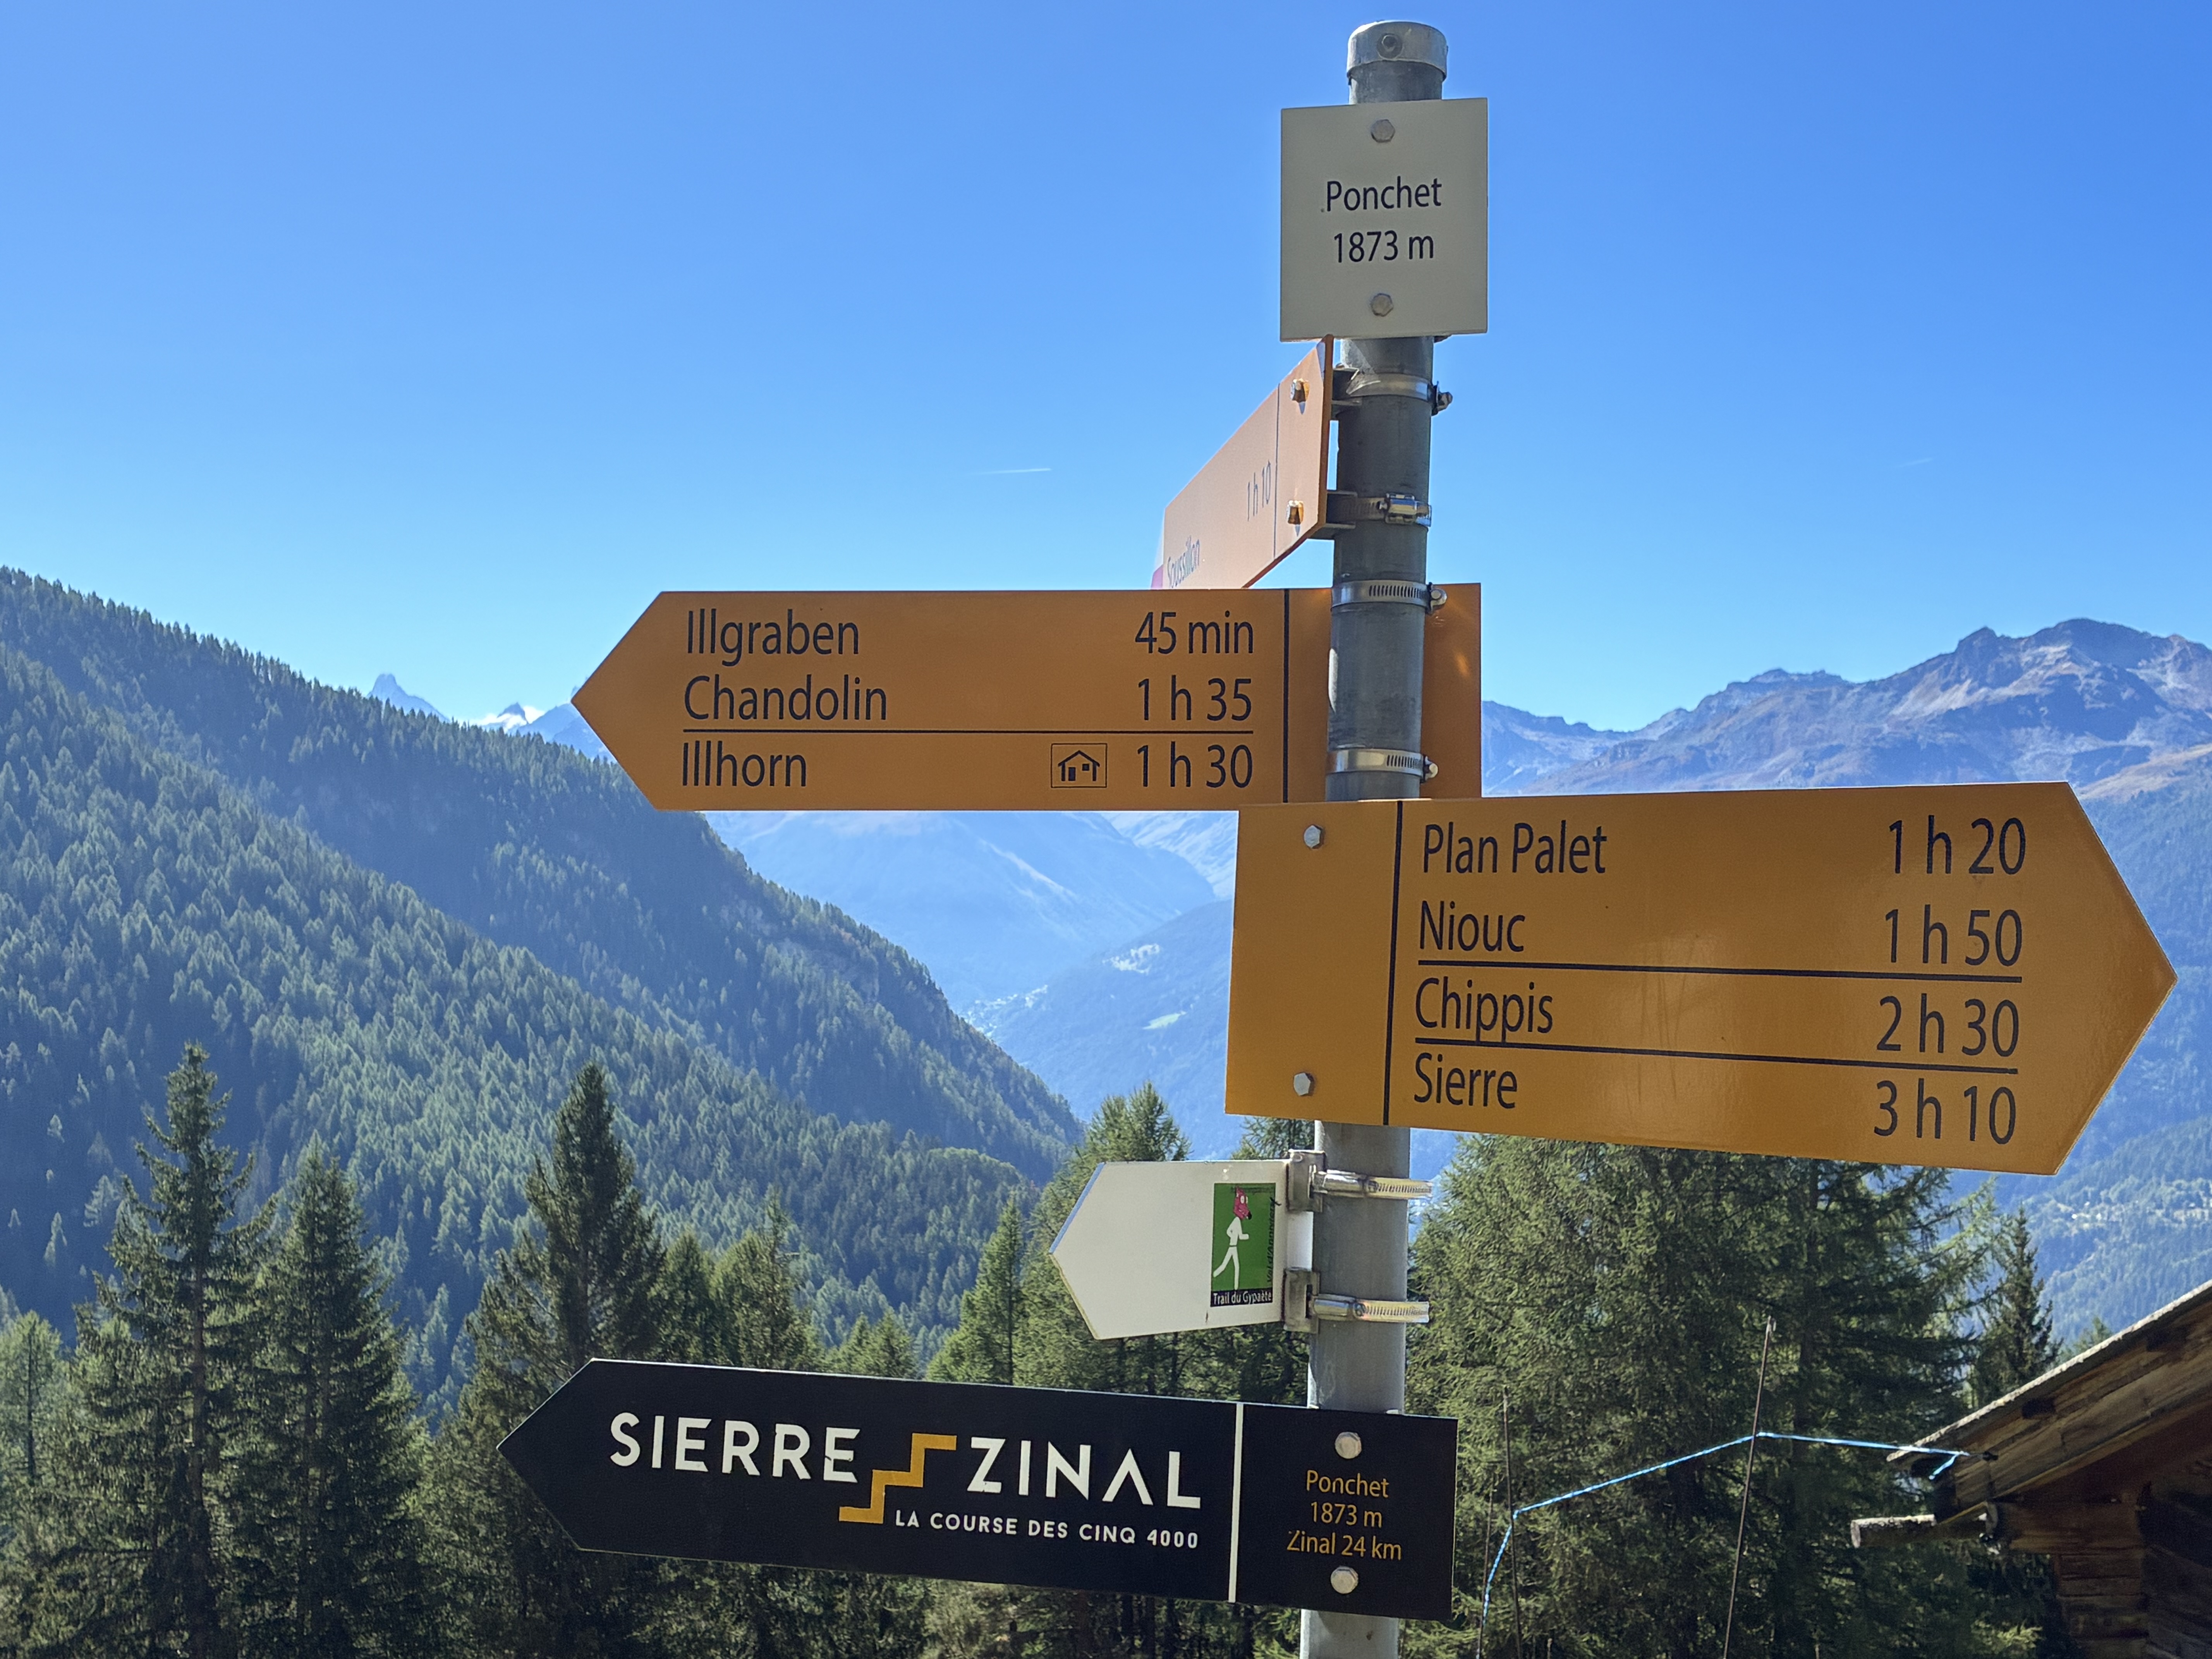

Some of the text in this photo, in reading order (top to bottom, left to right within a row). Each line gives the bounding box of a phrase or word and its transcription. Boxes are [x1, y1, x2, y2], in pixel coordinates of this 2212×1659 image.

[1327, 176, 1442, 211] Ponchet
[1334, 230, 1433, 263] 1873 m
[1253, 472, 1258, 516] h
[1262, 460, 1271, 508] 10
[688, 608, 858, 666] Illgraben
[1135, 610, 1253, 654] 45 min
[685, 674, 886, 720] Chandolin
[1139, 675, 1251, 721] 1 h 35
[683, 740, 806, 787] Illhorn
[1138, 741, 1252, 788] 1 h 30
[1424, 820, 1607, 873] Plan Palet
[1889, 815, 2026, 874] 1 h 20
[1420, 901, 1525, 952] Niouc
[1886, 904, 2022, 967] 1 h 50
[1415, 976, 1553, 1042] Chippis
[1877, 993, 2019, 1057] 2 h 30
[1414, 1053, 1517, 1109] Sierre
[1874, 1078, 2016, 1144] 3 h 10
[1213, 1292, 1229, 1304] Trail
[1231, 1291, 1241, 1303] du
[611, 1413, 1200, 1508] SIERRE ZINAL
[1307, 1470, 1389, 1498] Ponchet
[896, 1510, 1197, 1548] LA COURSE DES CINQ 4000
[1311, 1502, 1381, 1527] 1873 m
[1287, 1530, 1401, 1560] Zinal 24 km
